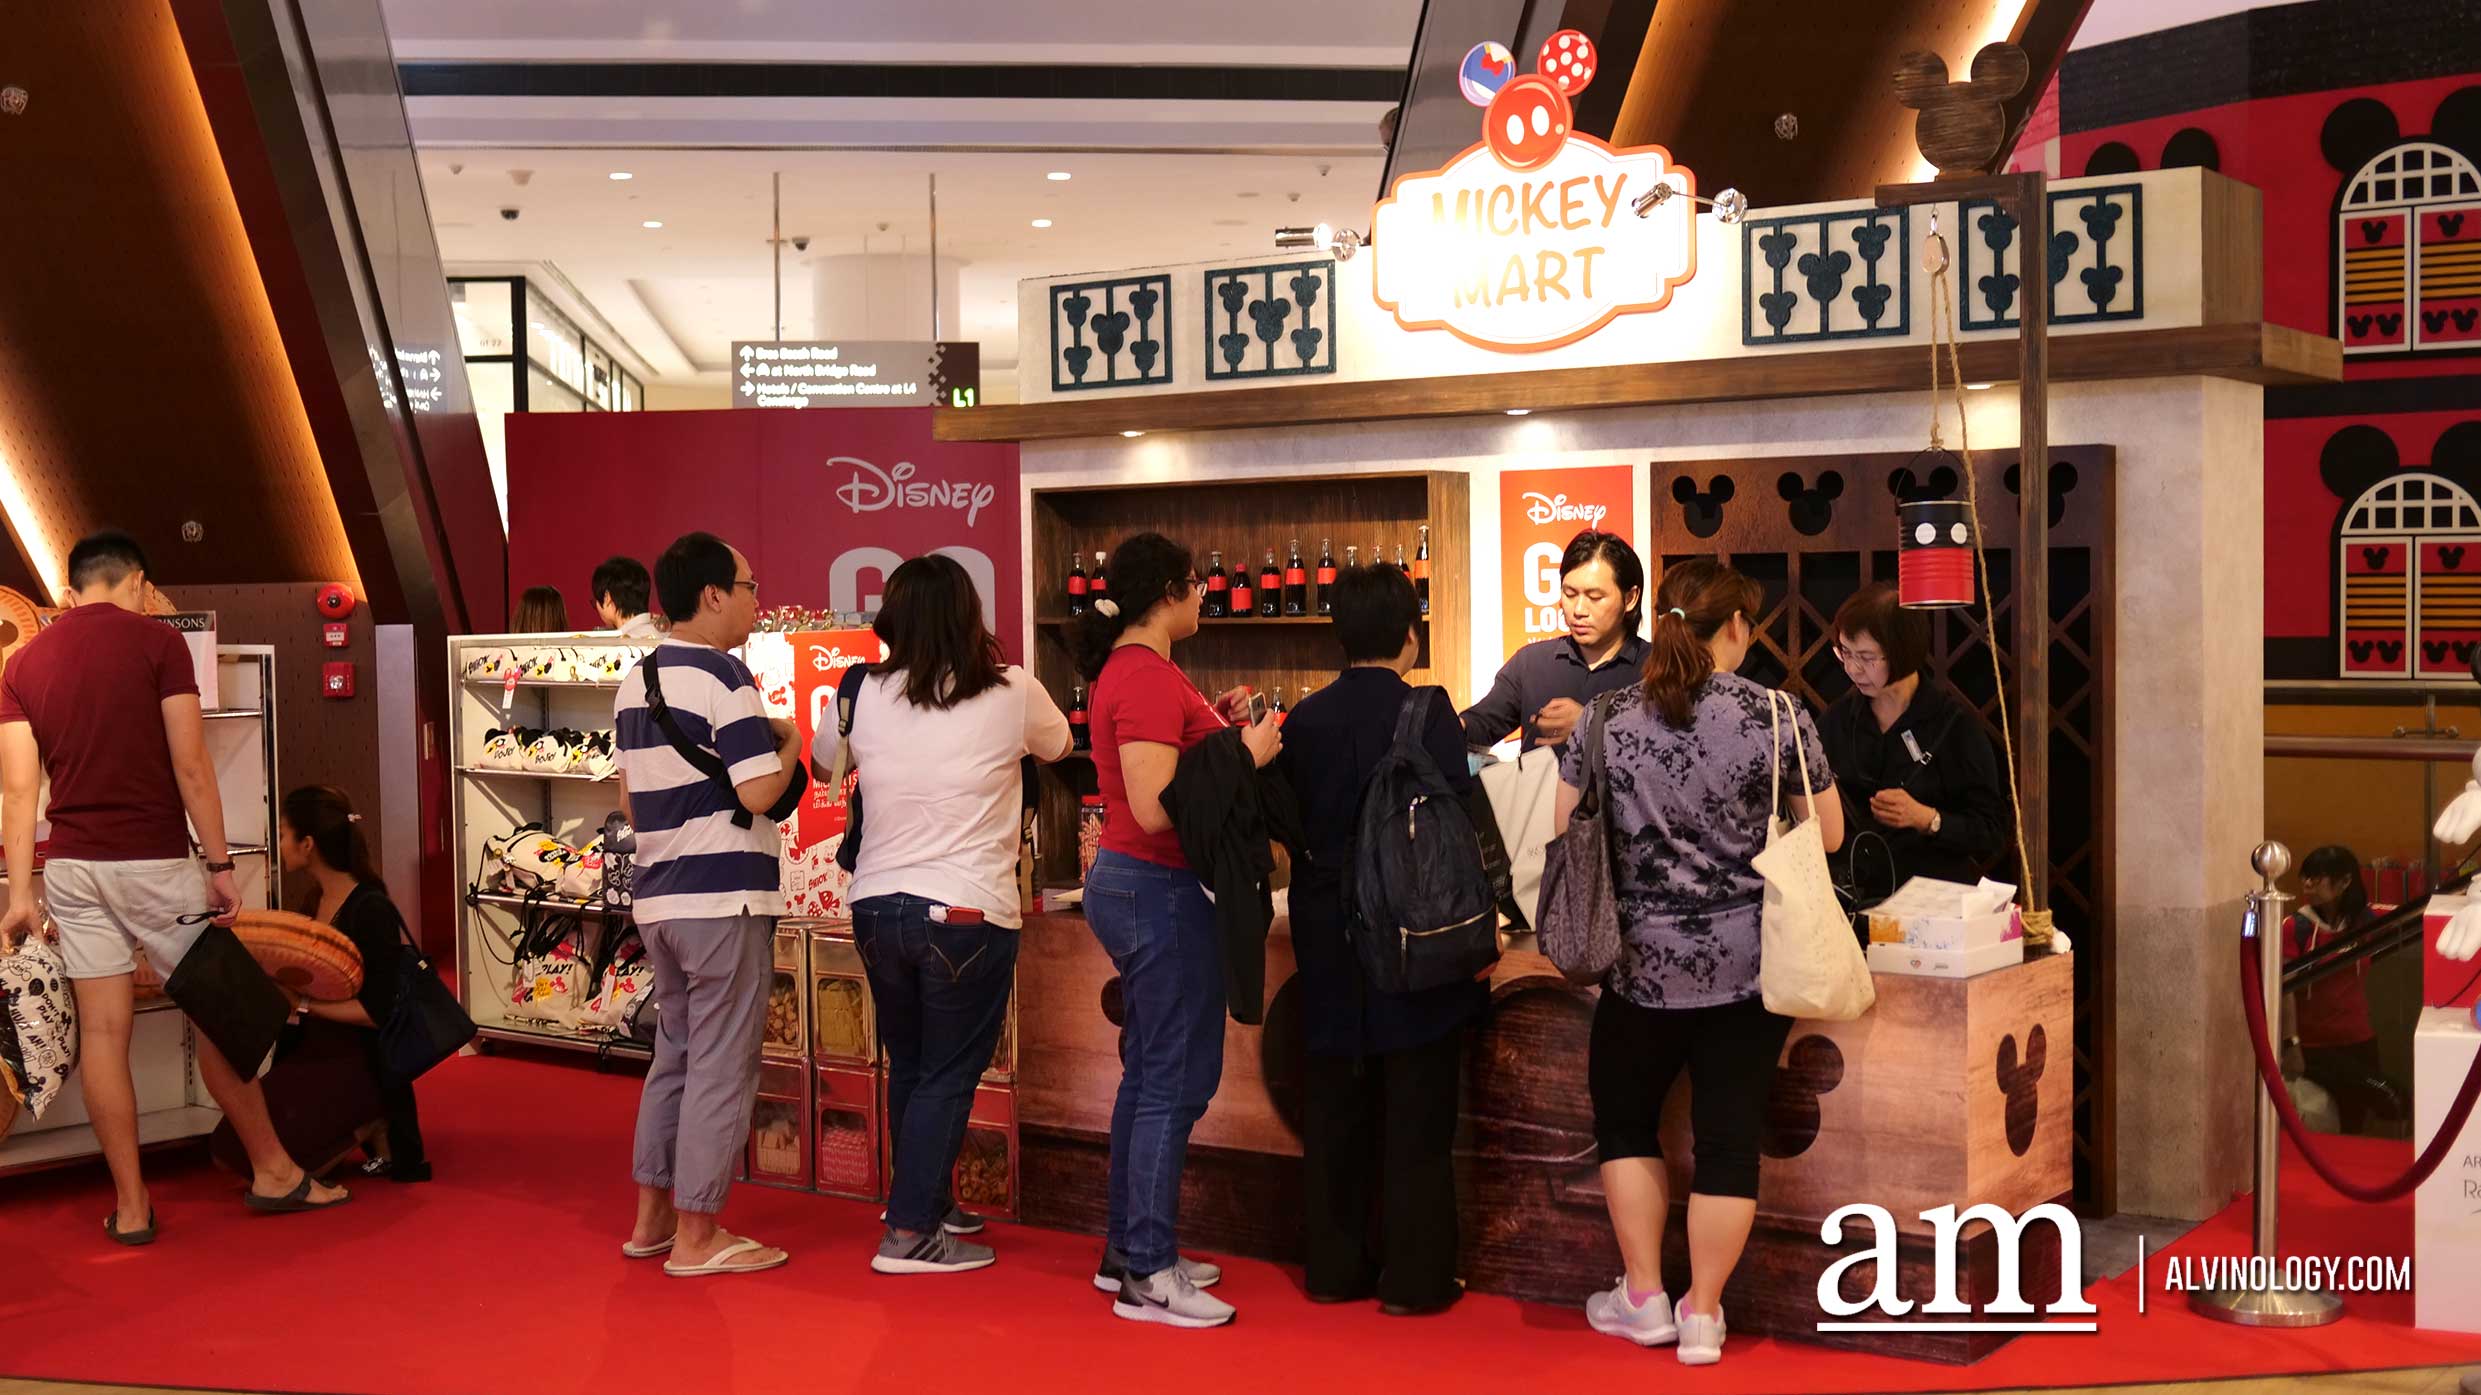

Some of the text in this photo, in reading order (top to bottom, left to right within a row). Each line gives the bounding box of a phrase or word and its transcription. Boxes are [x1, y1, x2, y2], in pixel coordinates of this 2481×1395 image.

[1431, 173, 1629, 238] MICKEY
[1453, 246, 1606, 310] MART
[850, 364, 876, 377] Road
[953, 388, 975, 408] L1
